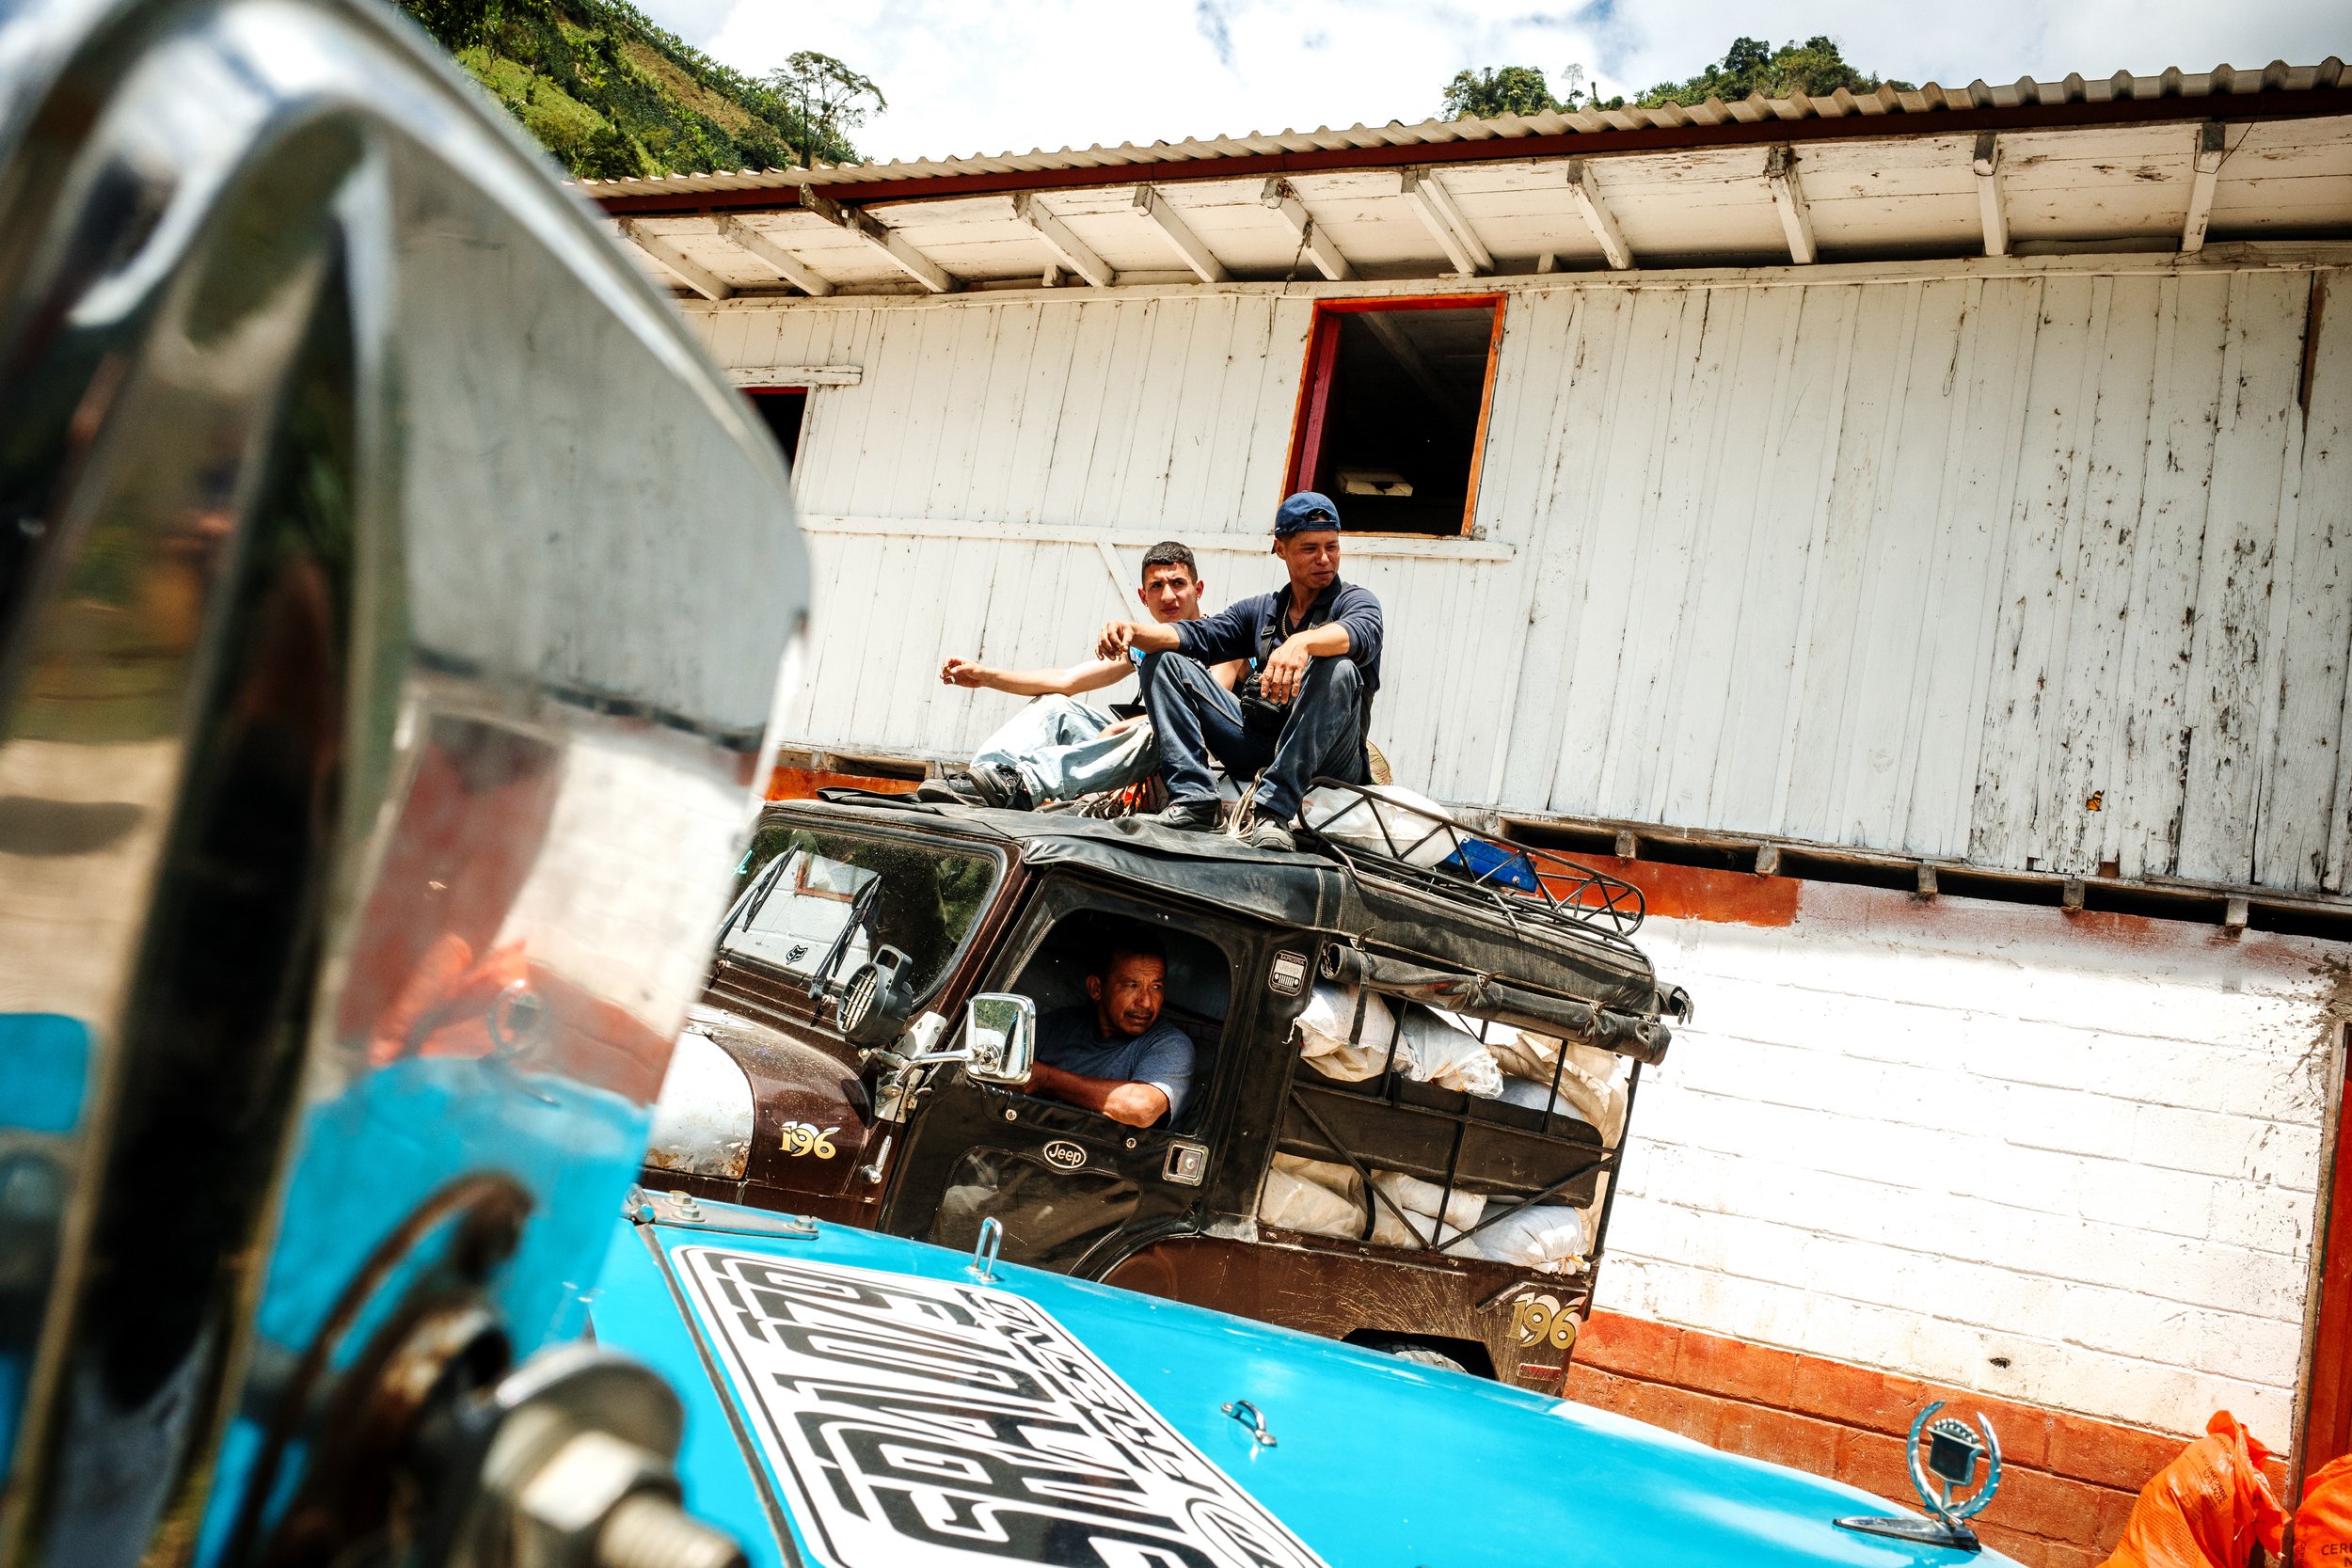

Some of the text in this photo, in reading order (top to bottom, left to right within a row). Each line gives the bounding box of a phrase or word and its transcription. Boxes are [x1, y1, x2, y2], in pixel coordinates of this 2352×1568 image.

[779, 1121, 840, 1159] 196
[1048, 1144, 1082, 1166] Jeep
[706, 1251, 1056, 1402] 079
[1506, 1292, 1587, 1350] 196
[956, 1288, 1223, 1498] FRESNO
[2207, 1465, 2229, 1501] ENGORDE
